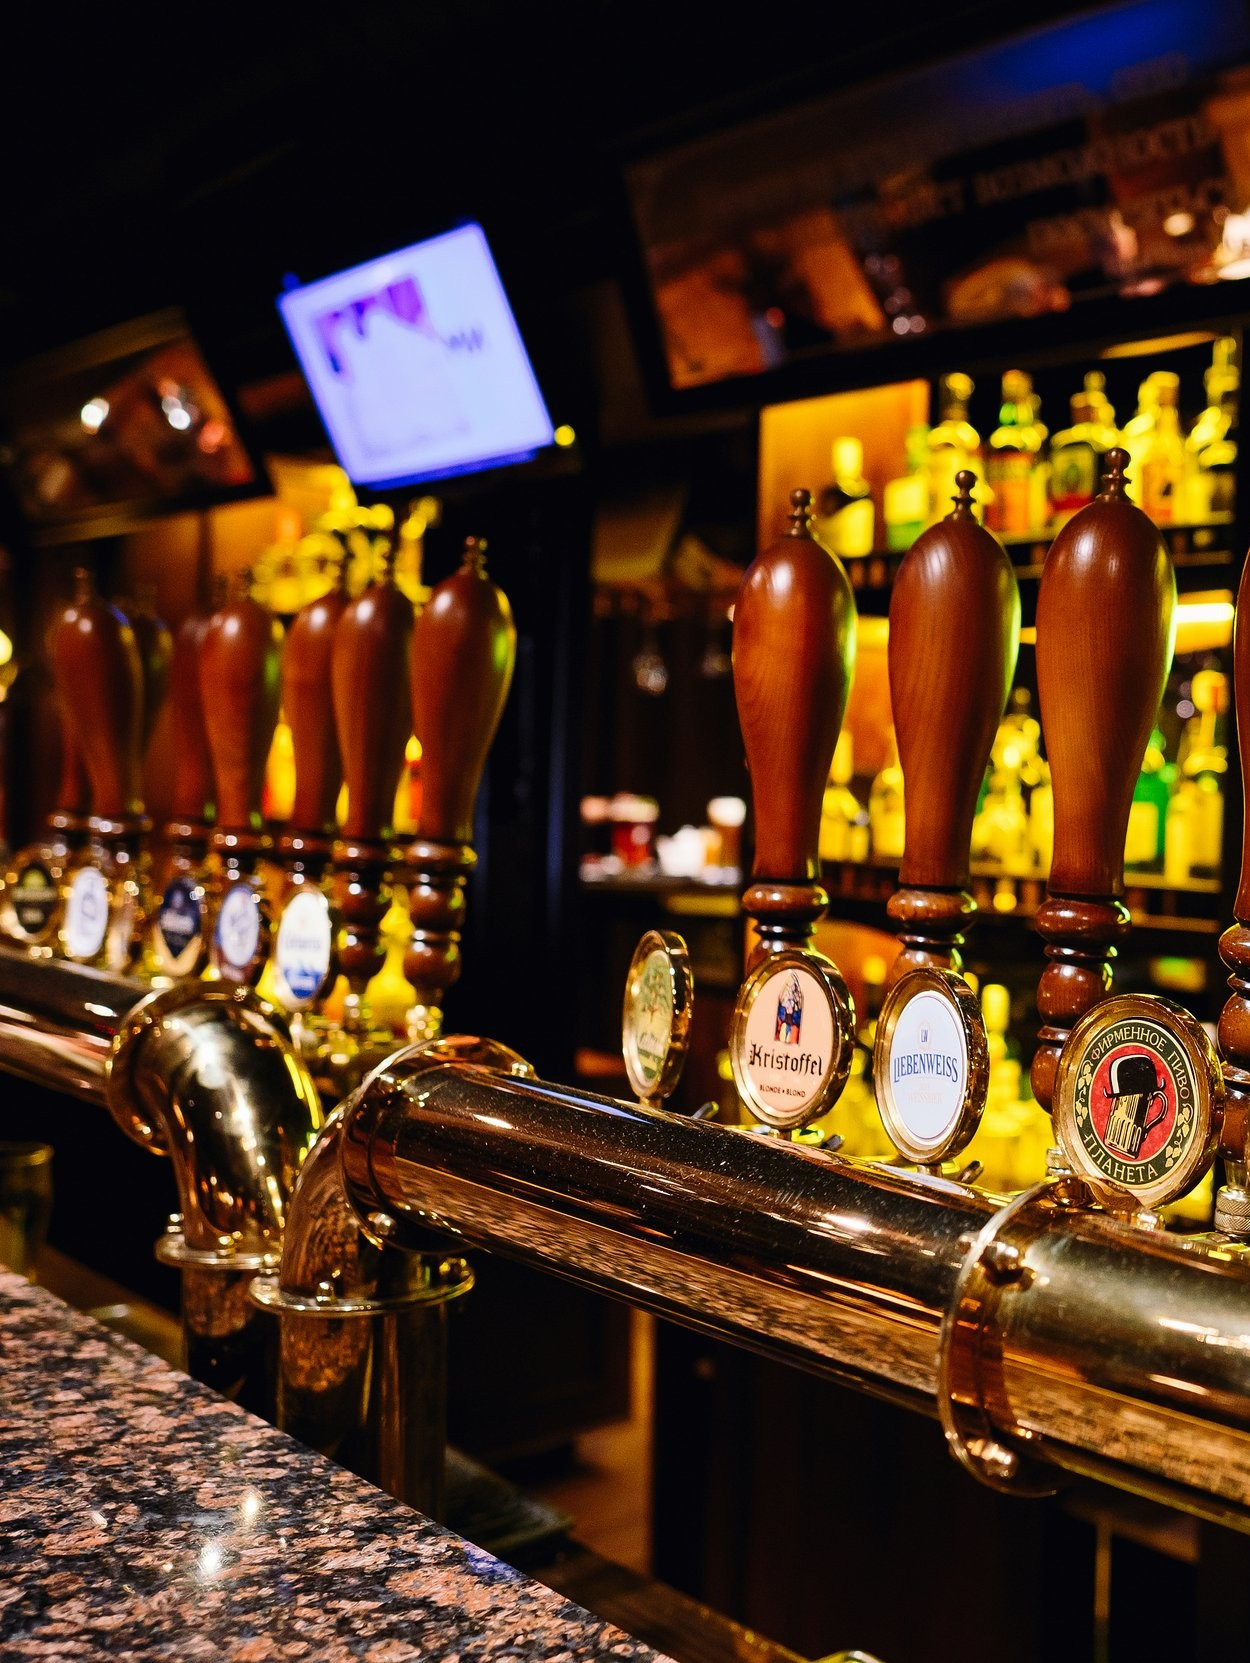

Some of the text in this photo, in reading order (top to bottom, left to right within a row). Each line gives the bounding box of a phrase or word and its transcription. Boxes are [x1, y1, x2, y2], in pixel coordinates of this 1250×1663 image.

[749, 1040, 823, 1077] Kristoffel
[893, 1053, 958, 1083] LIEBENWEISS
[1091, 1026, 1190, 1100] ФИРМЕННОЕ ПИВО
[759, 1084, 806, 1098] BLONDE BLOND
[1083, 1134, 1159, 1183] ПЛАНЕТА
